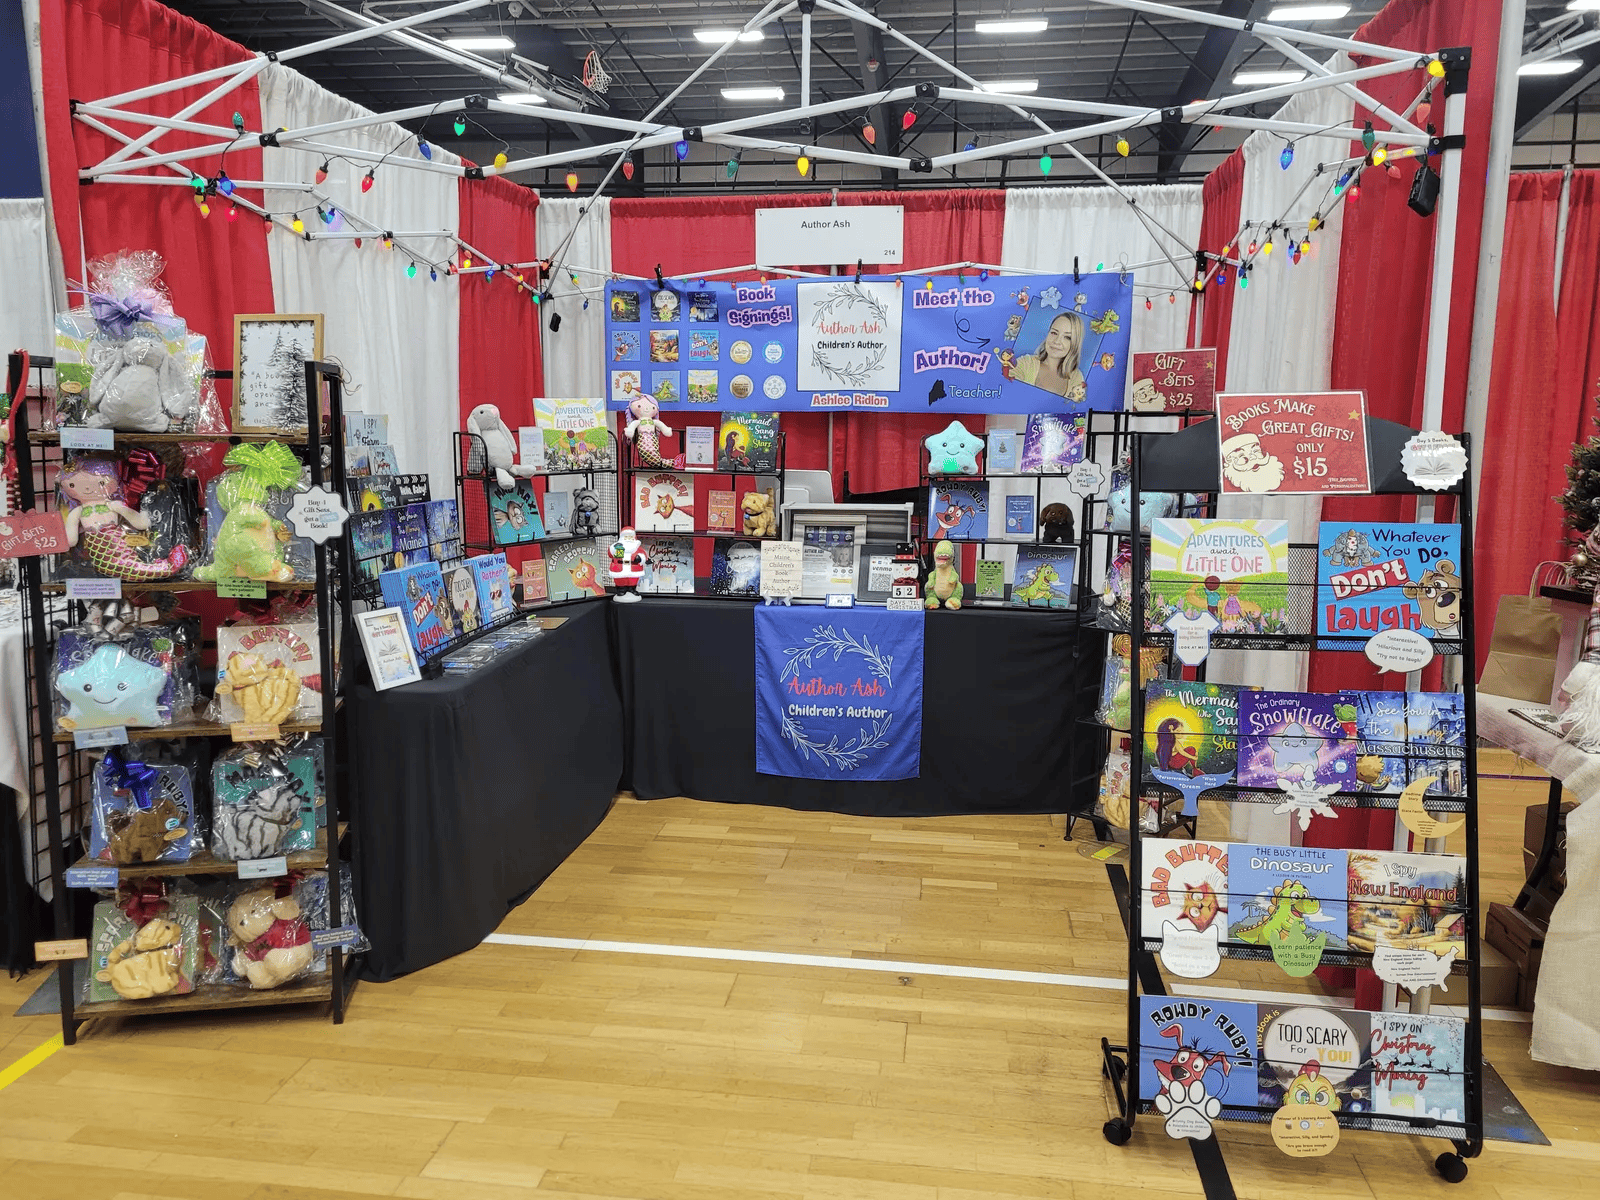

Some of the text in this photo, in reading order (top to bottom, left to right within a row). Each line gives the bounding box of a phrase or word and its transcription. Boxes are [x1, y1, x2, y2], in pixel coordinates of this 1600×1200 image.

[801, 220, 850, 229] Author Ash
[737, 286, 774, 302] Book
[915, 289, 993, 307] Meet the
[728, 306, 792, 325] Signings!
[816, 321, 883, 335] Author Ash
[817, 340, 885, 350] Children's Author
[916, 348, 990, 372] Author!
[1151, 353, 1186, 372] GIFT
[1163, 373, 1195, 387] SETS
[948, 385, 1002, 399] Teacher!
[1169, 392, 1193, 407] $25
[812, 394, 888, 406] Ashlee Ridlon
[555, 406, 594, 415] ADVENTURES
[1224, 398, 1316, 432] BOOKS MAKE
[578, 418, 595, 428] ONE
[736, 414, 772, 427] Mermaid
[1031, 420, 1078, 436] Snowflake
[754, 426, 775, 437] Sang
[1258, 420, 1355, 442] GREAT GIFTS!
[752, 439, 772, 449] Stars
[1296, 443, 1324, 453] ONLY
[1293, 456, 1328, 479] $15
[640, 474, 689, 509] BAD BUTTER!
[936, 482, 966, 497] ROWDY
[967, 486, 986, 513] RUBY!
[2, 526, 46, 554] GIFT SETS
[34, 536, 57, 550] $25
[1186, 533, 1264, 548] ADVENTURES
[1372, 528, 1450, 543] Whatever
[400, 538, 423, 551] Maine
[649, 544, 680, 559] Christmas
[549, 542, 575, 572] SCAREDY
[564, 546, 596, 562] SCOTCH!
[1027, 551, 1068, 560] Dinosaur
[1382, 545, 1448, 564] You DO,
[478, 556, 505, 569] Would You
[652, 560, 677, 573] Morning
[1231, 556, 1263, 573] ONE
[416, 568, 439, 580] Whatever
[482, 568, 507, 580] Rather?
[1330, 559, 1407, 598] Don't
[412, 593, 434, 626] Don't
[788, 676, 886, 697] Author Ash
[1164, 689, 1177, 698] The
[1269, 699, 1300, 707] Ordinary
[1376, 701, 1441, 717] See You in
[788, 704, 888, 718] Children's Author
[1250, 706, 1341, 734] Snowflake
[1367, 720, 1392, 735] the
[1356, 743, 1464, 757] Massachusetts
[1256, 848, 1326, 859] THE BUSY LITTLE
[1250, 858, 1334, 874] Dinosaur
[1383, 863, 1417, 879] I Spy
[1151, 867, 1171, 908] BAD
[1348, 879, 1458, 902] New England
[1294, 944, 1322, 952] patience
[1301, 951, 1316, 961] Busy
[1258, 1016, 1272, 1033] Book
[1272, 1009, 1280, 1019] is
[1384, 1021, 1423, 1033] I SPY ON
[1150, 1002, 1254, 1068] ROWDY RUBY!
[1278, 1023, 1348, 1047] TOO SCARY
[1371, 1028, 1436, 1056] Christmas
[1291, 1045, 1307, 1054] For
[1375, 1062, 1428, 1091] Morning
